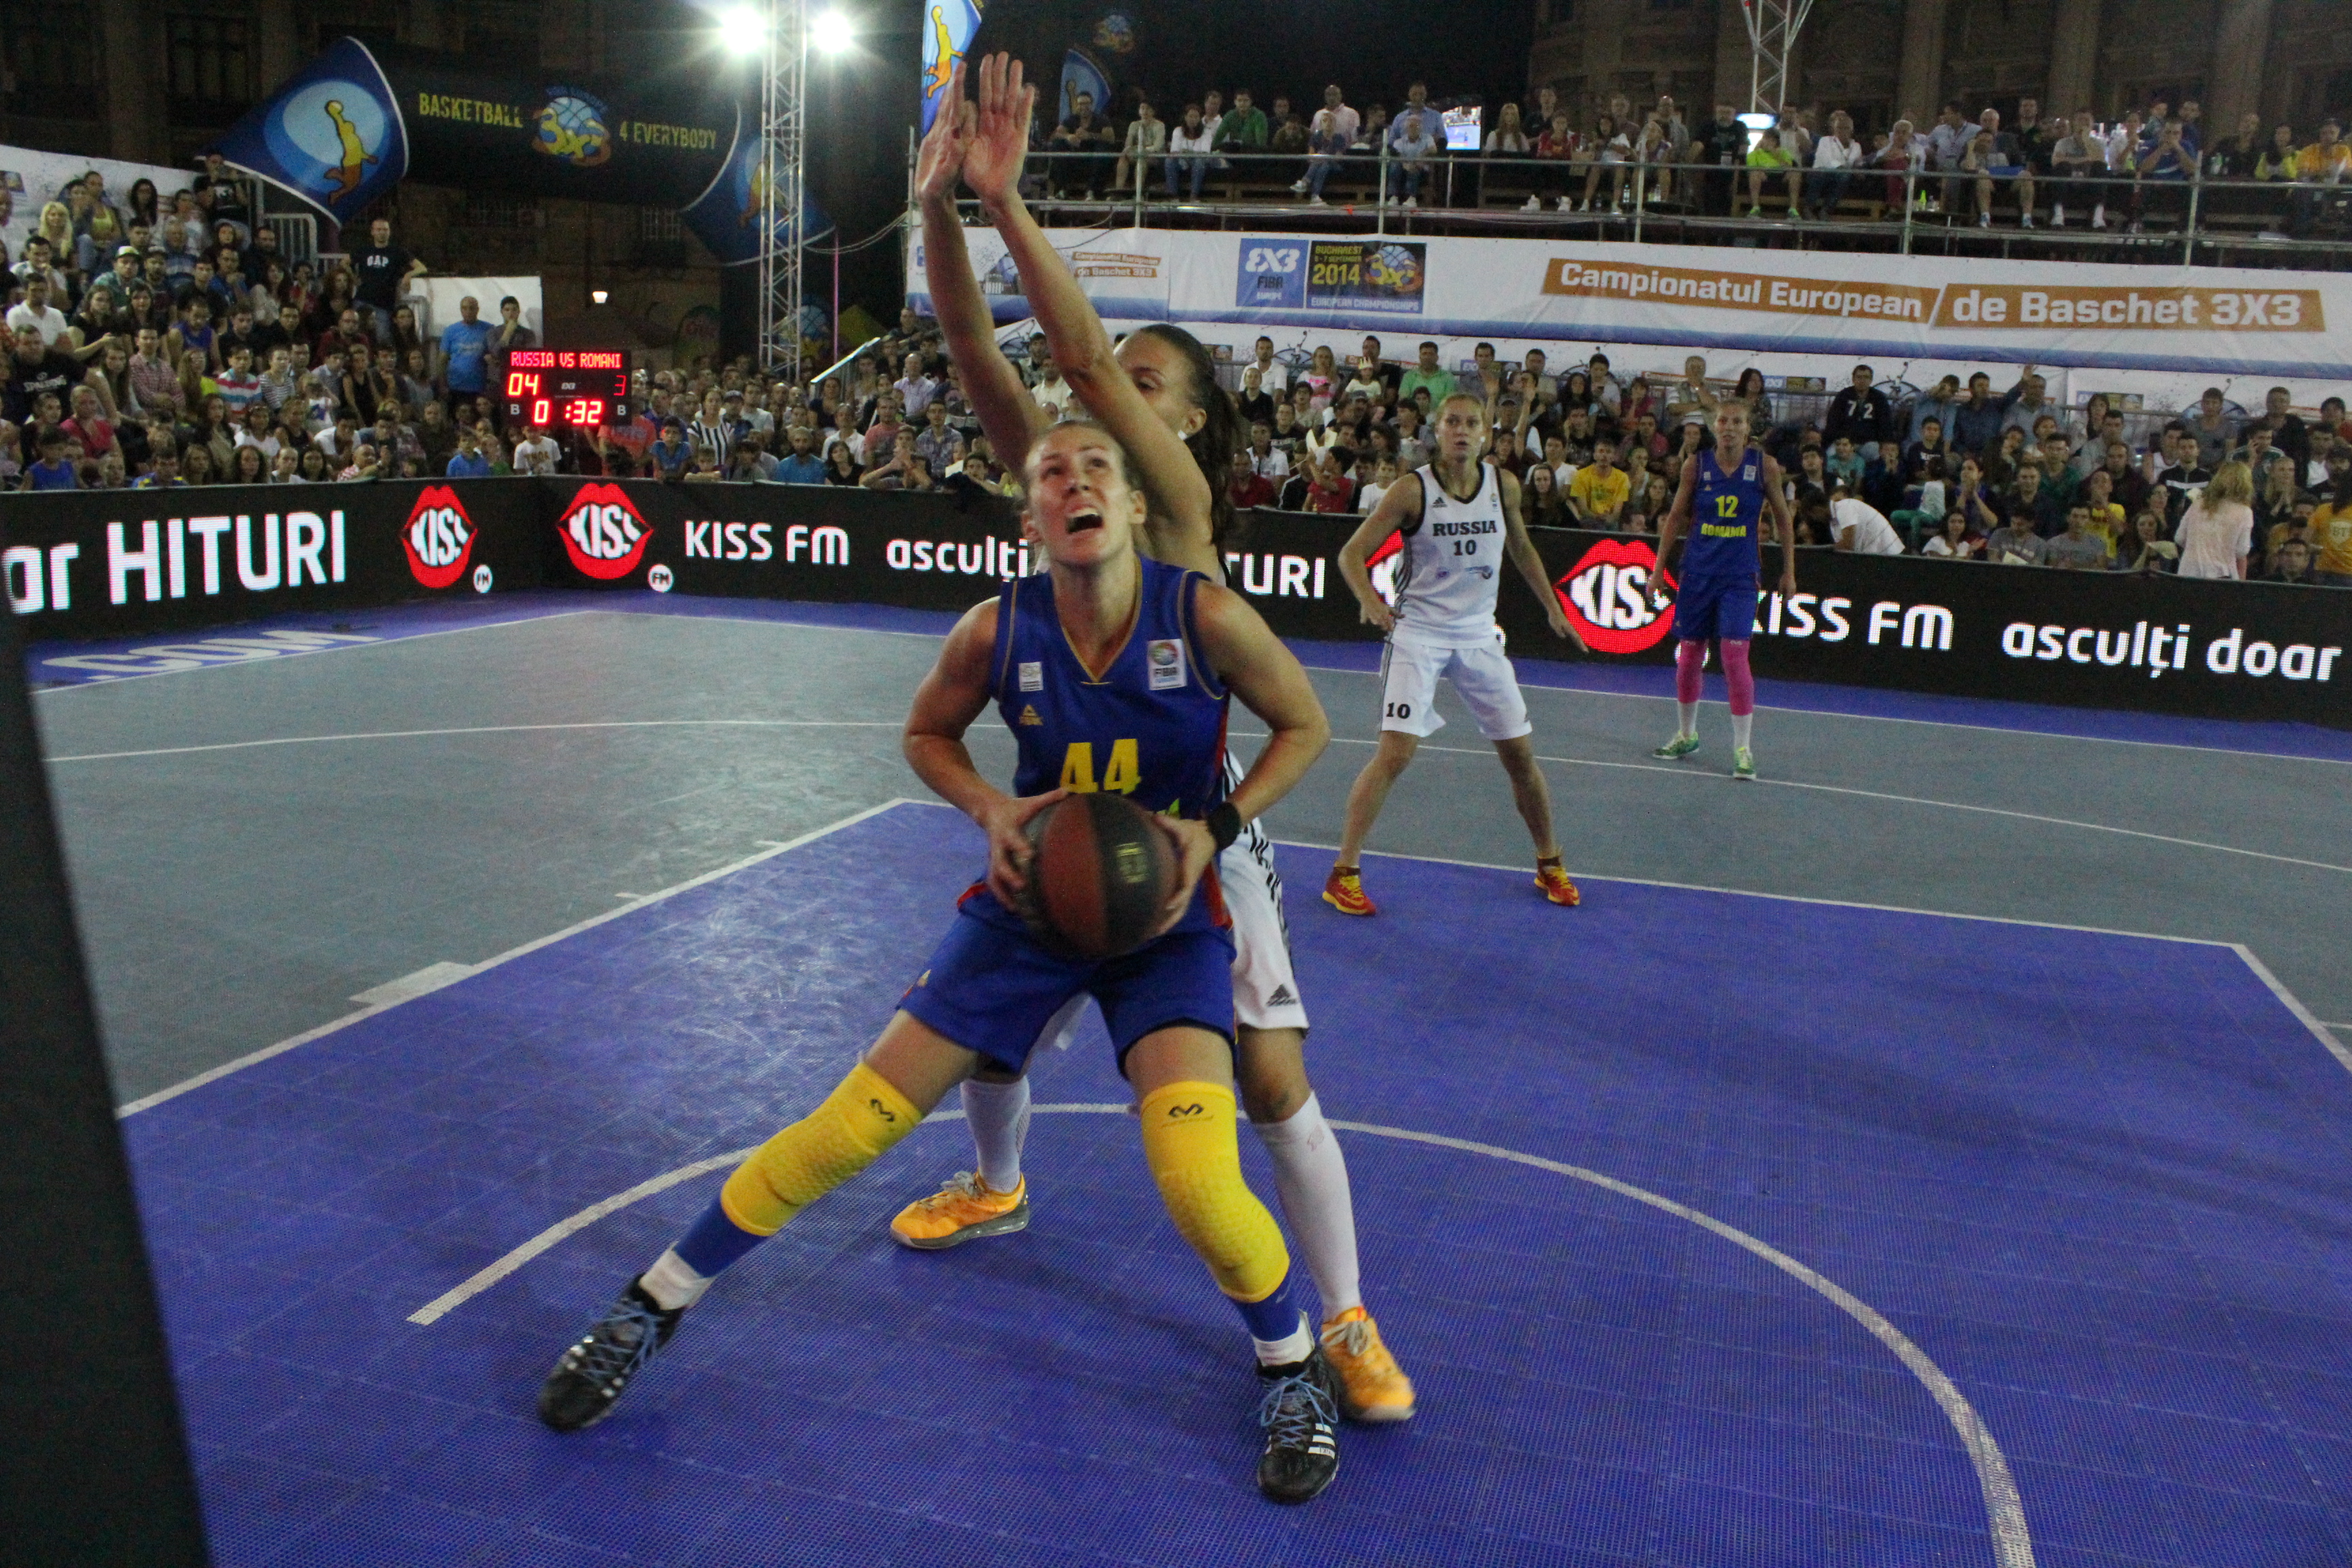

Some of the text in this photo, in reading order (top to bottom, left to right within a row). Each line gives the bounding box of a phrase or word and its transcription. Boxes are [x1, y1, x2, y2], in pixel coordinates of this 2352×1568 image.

[419, 93, 523, 128] BASKETBALL
[619, 121, 717, 149] 4 EVERYBODY
[1316, 245, 1363, 255] BUCHAREST
[1257, 276, 1284, 289] FIBA
[1312, 263, 1360, 285] 2014
[1257, 292, 1282, 300] EUROPE
[1561, 262, 1923, 318] Campionatul European
[1311, 297, 1419, 311] EUROPEAN CHAMPIONSHIPS
[1953, 290, 2300, 325] de Baschet 3X3
[510, 351, 622, 368] RUSSIA VS ROMANI
[508, 373, 539, 396] 04
[613, 375, 626, 395] 3
[510, 404, 520, 415] B
[617, 405, 626, 415] B
[1715, 495, 1739, 518] 12
[1433, 521, 1497, 536] RUSSIA
[1701, 523, 1747, 538] ROMANIA
[685, 519, 772, 561] KISS
[785, 525, 849, 566] FM
[1454, 540, 1477, 556] 10
[107, 510, 345, 605] HITURI
[1867, 601, 1953, 651] FM
[2206, 628, 2342, 681] doar
[1386, 702, 1411, 719] 10
[1060, 738, 1141, 794] 44
